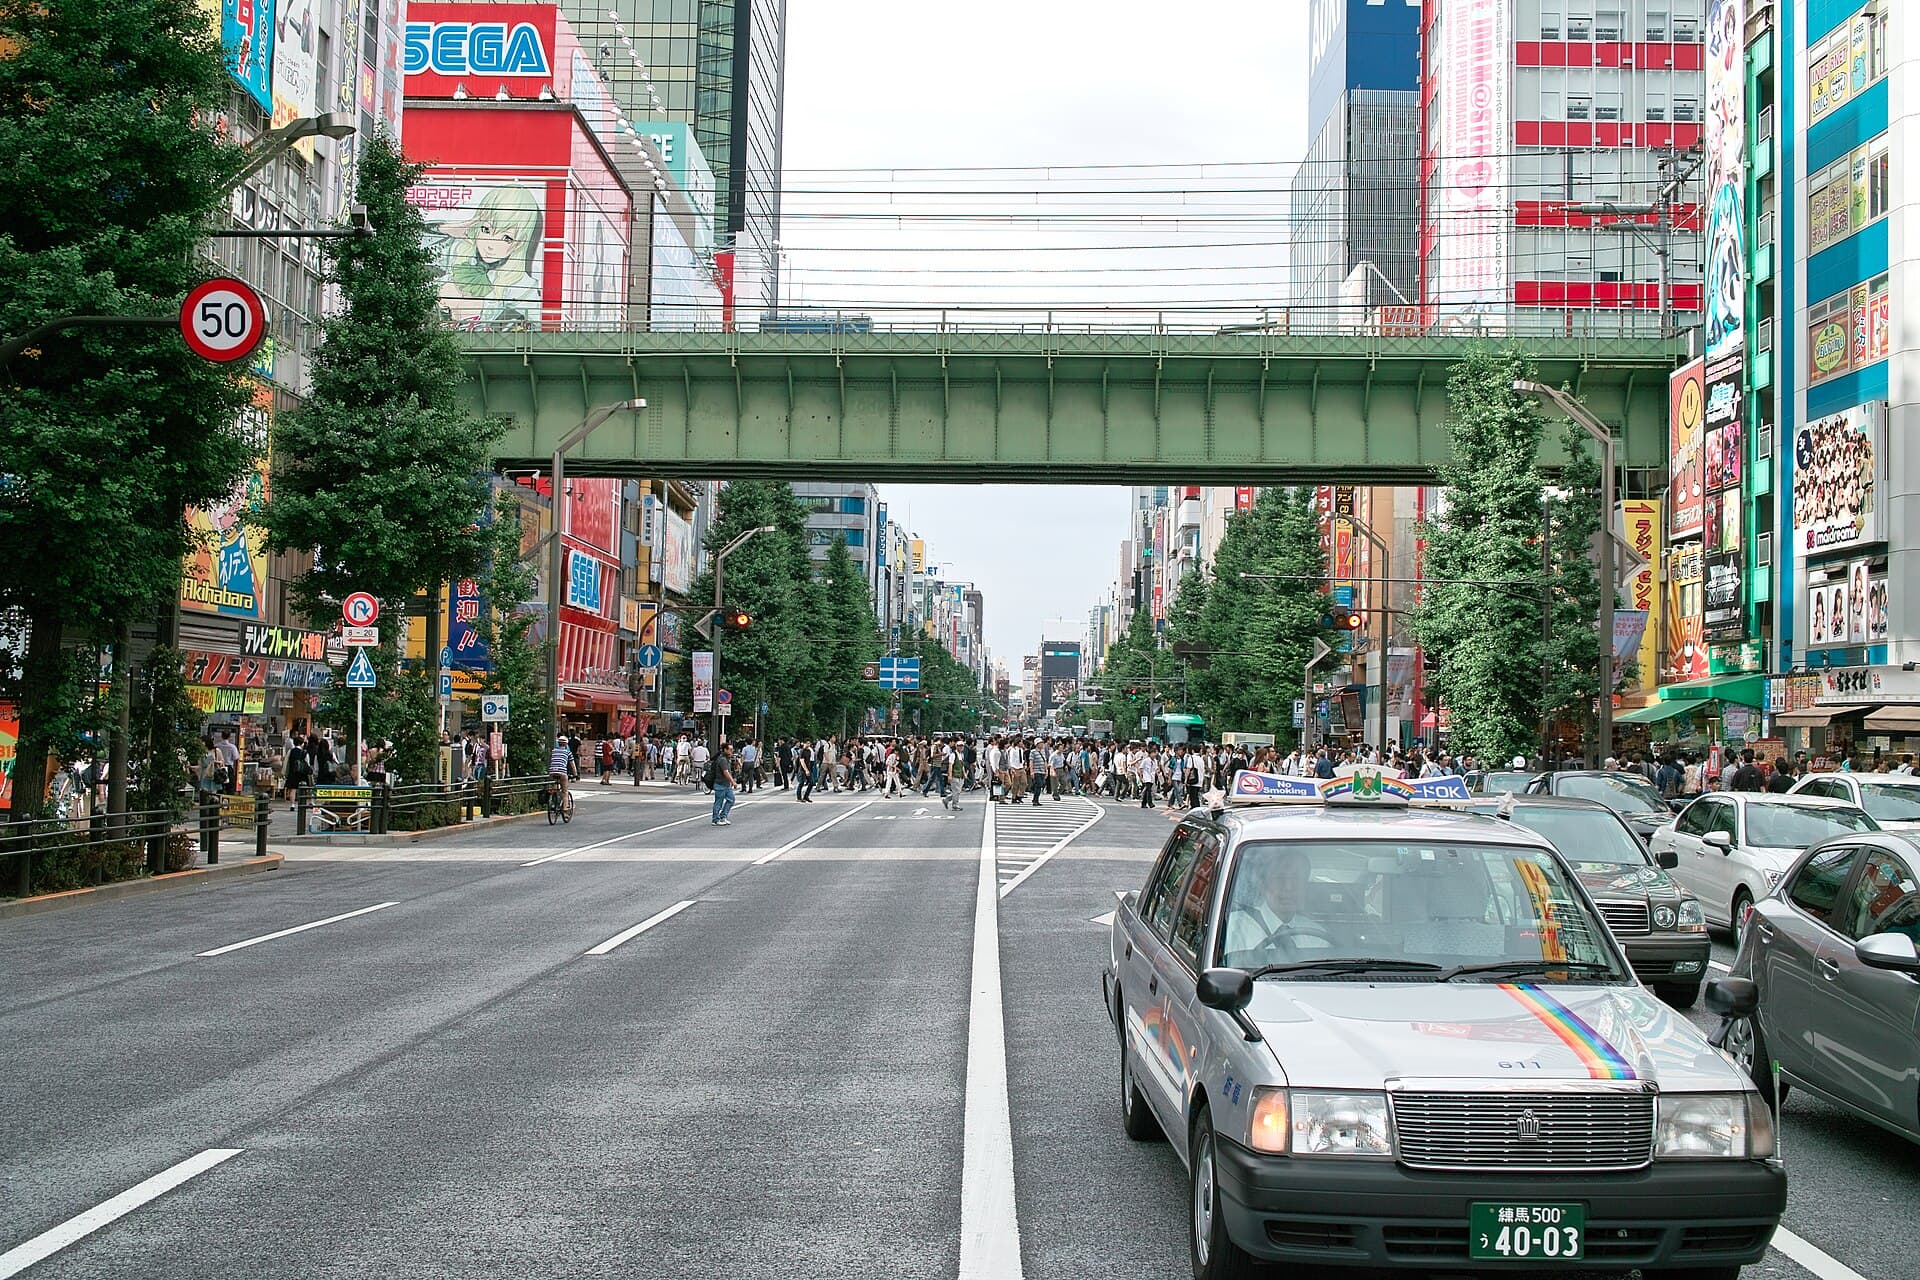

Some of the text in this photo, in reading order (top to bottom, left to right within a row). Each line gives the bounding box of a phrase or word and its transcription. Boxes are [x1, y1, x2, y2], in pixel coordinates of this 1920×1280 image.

[404, 23, 551, 76] SEGA
[406, 188, 472, 200] BORDER
[201, 303, 246, 338] 50
[1383, 307, 1419, 325] VID
[1337, 493, 1353, 503] アニメ
[1339, 505, 1349, 514] CD
[925, 566, 939, 575] ET
[1635, 519, 1653, 610] ラジセンタ
[569, 552, 600, 612] SEGA
[184, 577, 253, 609] Akihabara
[192, 653, 259, 685] オノデン
[284, 661, 306, 688] Digital
[442, 677, 450, 692] P
[216, 689, 244, 711] ONODEN
[1297, 703, 1305, 712] P
[1263, 787, 1307, 795] Smoking
[1498, 1061, 1542, 1069] 611
[1498, 1207, 1560, 1223] 練馬 500
[1480, 1226, 1578, 1257] う 40-03
